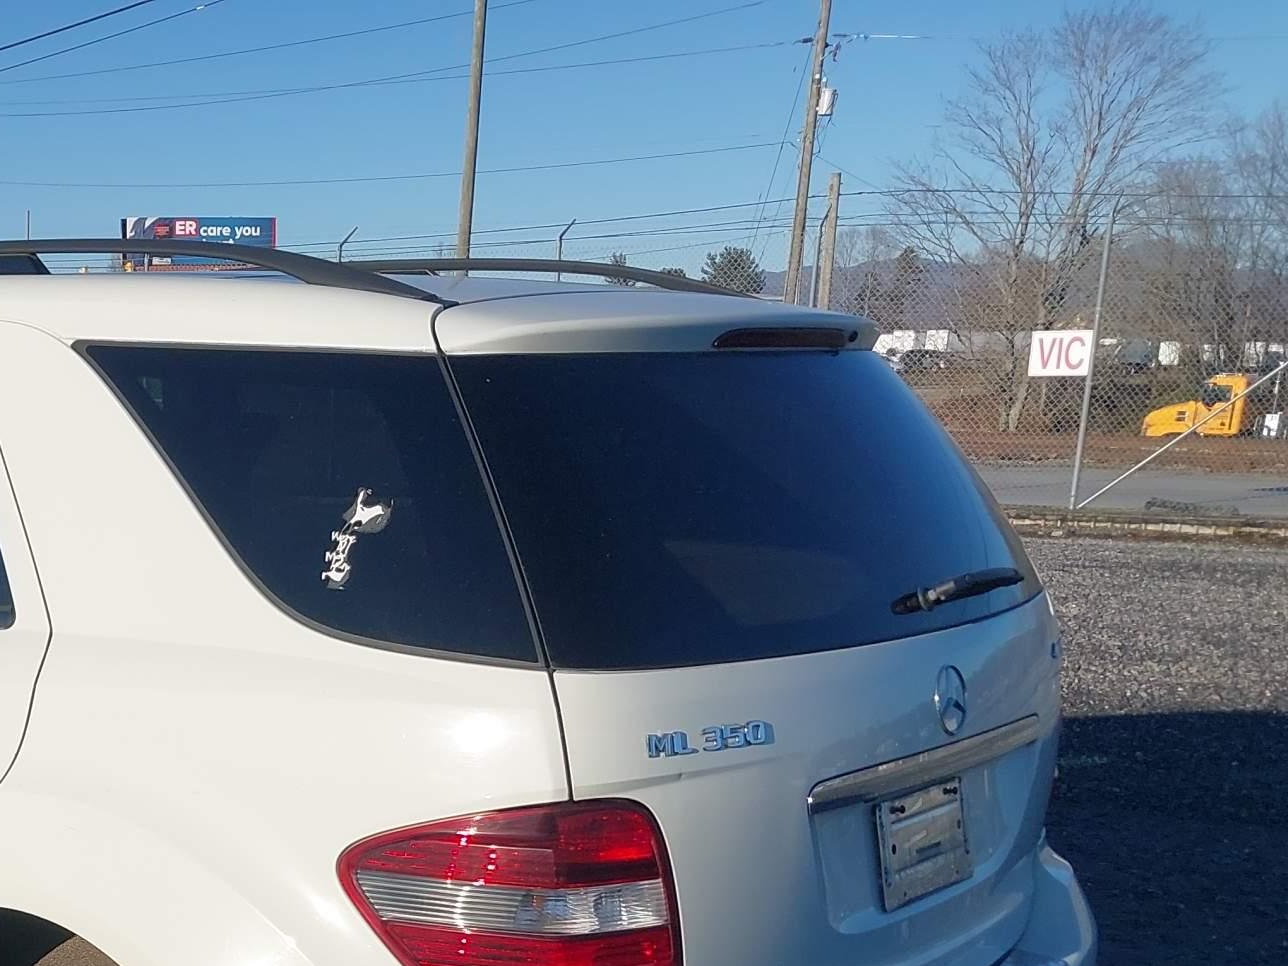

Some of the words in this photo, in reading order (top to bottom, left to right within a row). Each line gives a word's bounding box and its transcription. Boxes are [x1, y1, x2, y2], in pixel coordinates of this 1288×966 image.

[175, 221, 197, 235] ER
[200, 225, 231, 236] care
[234, 225, 261, 239] you
[1038, 336, 1086, 370] VIC
[647, 730, 698, 758] ML
[700, 719, 776, 752] 350
